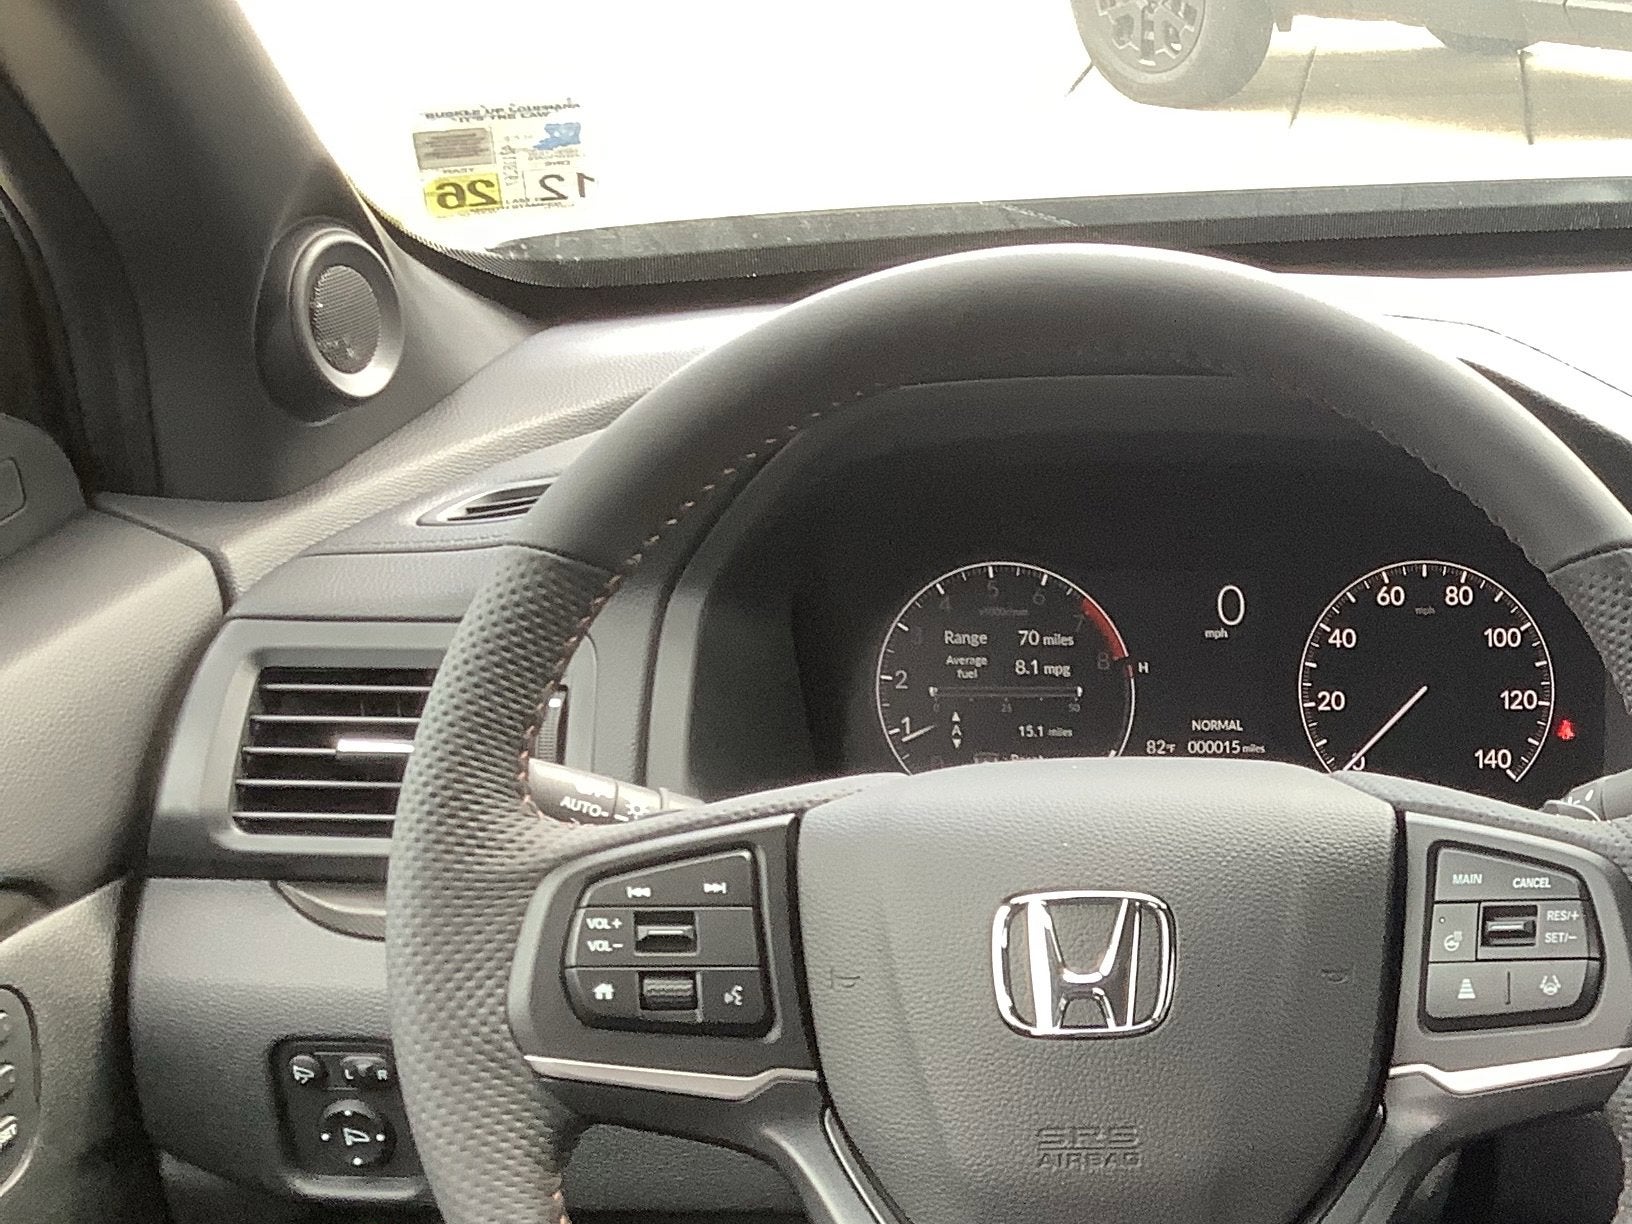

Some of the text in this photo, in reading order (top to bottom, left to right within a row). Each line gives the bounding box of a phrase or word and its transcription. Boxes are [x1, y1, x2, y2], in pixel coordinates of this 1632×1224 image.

[1217, 585, 1246, 626] 0
[1376, 586, 1406, 606] 60
[1445, 586, 1474, 606] 80
[944, 629, 1075, 648] Range 70 miles
[1204, 627, 1229, 640] mph
[1328, 628, 1357, 649] 40
[1483, 627, 1522, 648] 100
[945, 655, 1072, 678] Average 8.1 mpg
[956, 668, 978, 679] fuel
[1138, 662, 1149, 674] H
[895, 670, 908, 689] 2
[1317, 691, 1346, 711] 20
[1500, 690, 1538, 710] 120
[901, 716, 912, 735] 1
[1018, 724, 1045, 737] 15.1
[1191, 719, 1244, 732] NORMAL
[1187, 740, 1241, 754] 000015
[1474, 749, 1512, 769] 140
[560, 796, 602, 818] AUTO
[1452, 873, 1483, 885] MAIN
[1512, 877, 1552, 889] CANCEL
